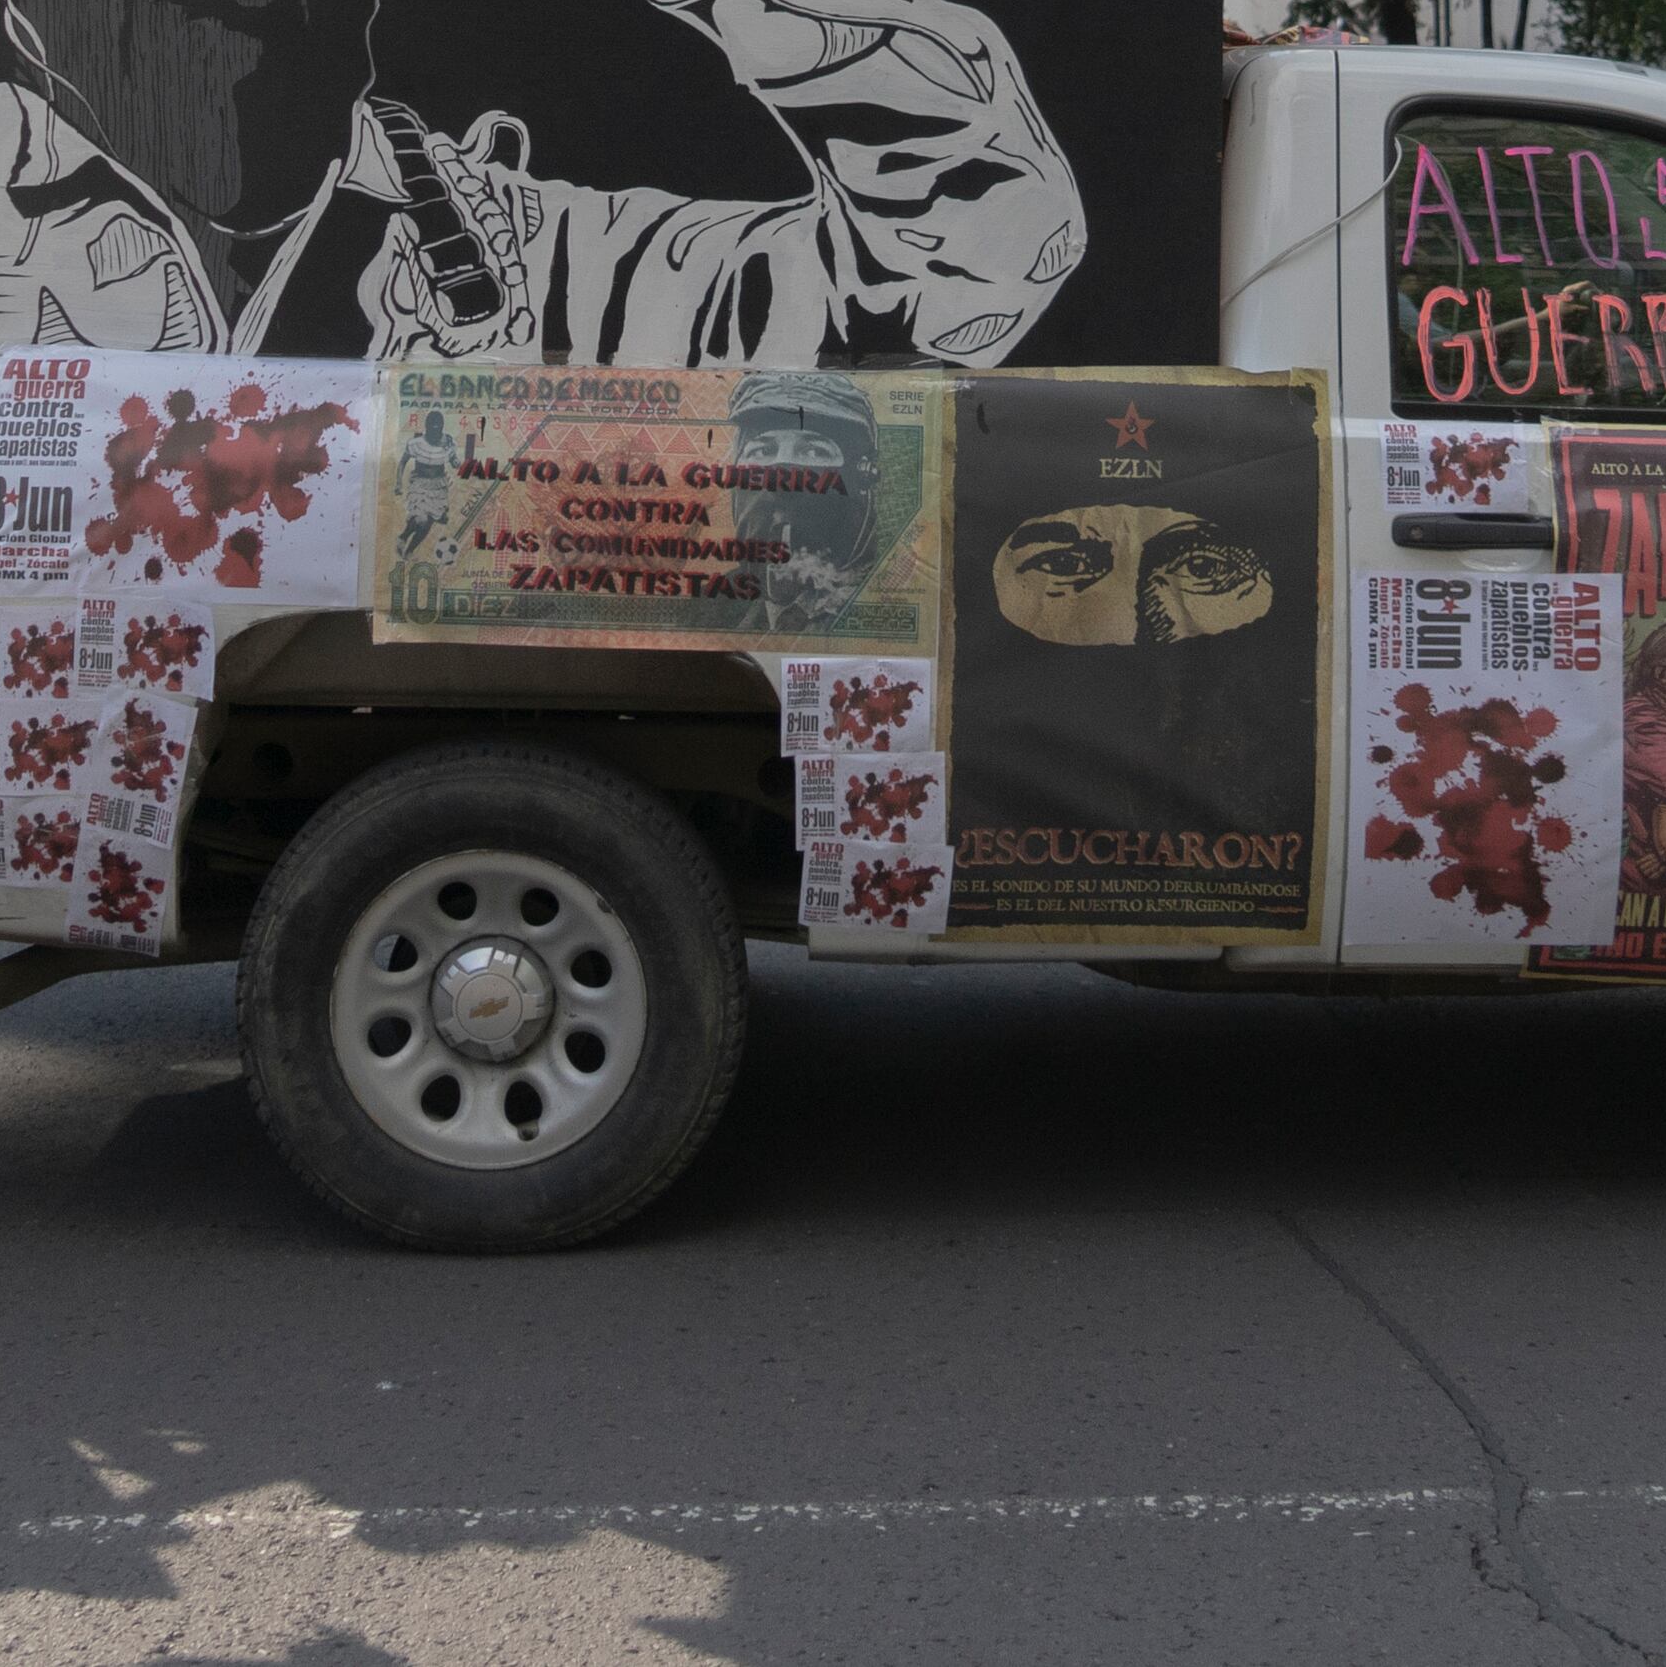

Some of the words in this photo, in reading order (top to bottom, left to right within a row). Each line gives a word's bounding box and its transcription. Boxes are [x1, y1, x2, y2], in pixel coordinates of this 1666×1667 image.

[1401, 144, 1619, 269] ALTO
[2, 359, 91, 380] ALTO
[13, 380, 85, 401] guerra
[400, 373, 436, 397] EL
[439, 374, 531, 400] BANCO
[536, 376, 570, 401] DE
[584, 376, 681, 404] MEXICO
[889, 390, 925, 402] SERIE
[893, 405, 923, 415] EZLN
[459, 458, 561, 483] ALTO
[570, 460, 602, 485] A
[616, 462, 669, 487] LA
[681, 461, 849, 497] GUERRA
[1099, 458, 1163, 478] EZLN
[1591, 463, 1629, 476] ALTO
[1632, 465, 1642, 476] A
[1645, 464, 1665, 476] LA
[460, 490, 484, 518] EZLN
[558, 496, 711, 527] CONTRA
[29, 534, 71, 544] Global
[473, 528, 540, 553] LAS
[551, 533, 791, 565] COMUNIDADES
[29, 570, 39, 580] 4
[43, 572, 69, 581] pm
[509, 563, 761, 601] ZAPATISTAS
[81, 599, 116, 611] ALTO
[387, 560, 439, 624] 10
[454, 594, 518, 618] DIEZ
[1368, 577, 1379, 624] CDMX
[1369, 627, 1379, 638] 4
[1391, 577, 1403, 669] Marcha
[1489, 580, 1509, 670] zapatistas
[1509, 581, 1532, 671] pueblos
[1532, 582, 1552, 659] contra
[1551, 595, 1574, 670] guerra
[1573, 582, 1601, 671] ALTO
[1368, 642, 1377, 669] pm
[1404, 626, 1414, 669] Global
[787, 663, 820, 674] ALTO
[801, 759, 835, 771] ALTO
[811, 841, 845, 854] ALTO
[955, 827, 1303, 870] ¿ESCUCHARON?
[972, 881, 989, 892] EL
[992, 881, 1050, 893] SONIDO
[1055, 881, 1074, 893] DE
[1078, 880, 1096, 893] SU
[1101, 880, 1160, 893] MUNDO
[996, 899, 1012, 911] ES
[1016, 899, 1034, 911] EL
[1037, 899, 1066, 911] DEL
[1069, 899, 1143, 912] NUESTRO
[1146, 899, 1255, 913] RESURGIENDO
[1648, 895, 1661, 927] A
